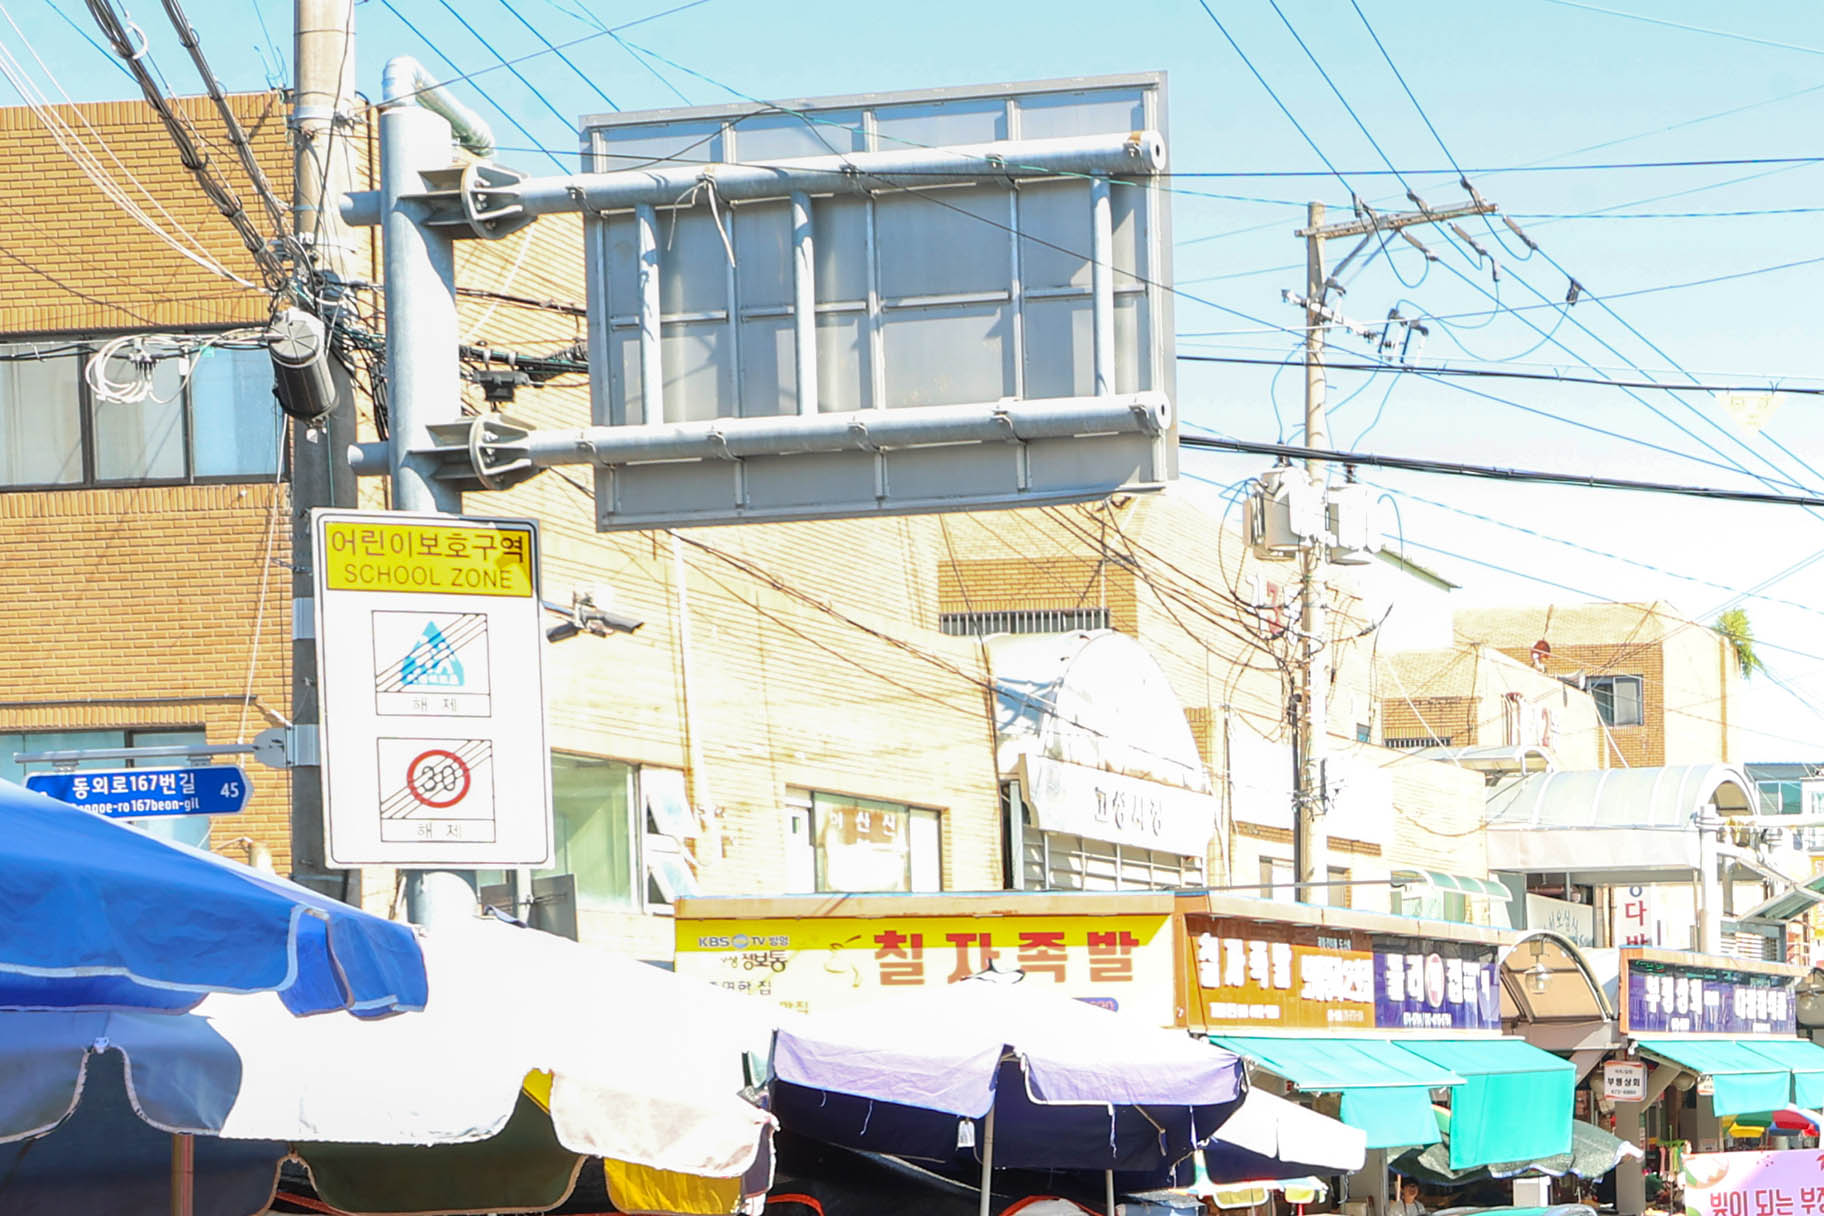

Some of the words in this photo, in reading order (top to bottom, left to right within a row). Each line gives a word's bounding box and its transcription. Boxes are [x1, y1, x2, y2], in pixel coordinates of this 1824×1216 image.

[332, 529, 524, 564] 어린이보호구역
[344, 564, 441, 586] SCHOOL
[451, 568, 512, 589] ZONE
[219, 782, 240, 798] 45
[422, 765, 456, 791] 30
[699, 936, 730, 947] KBS
[751, 936, 766, 946] TV
[1755, 1188, 1794, 1216] 되는
